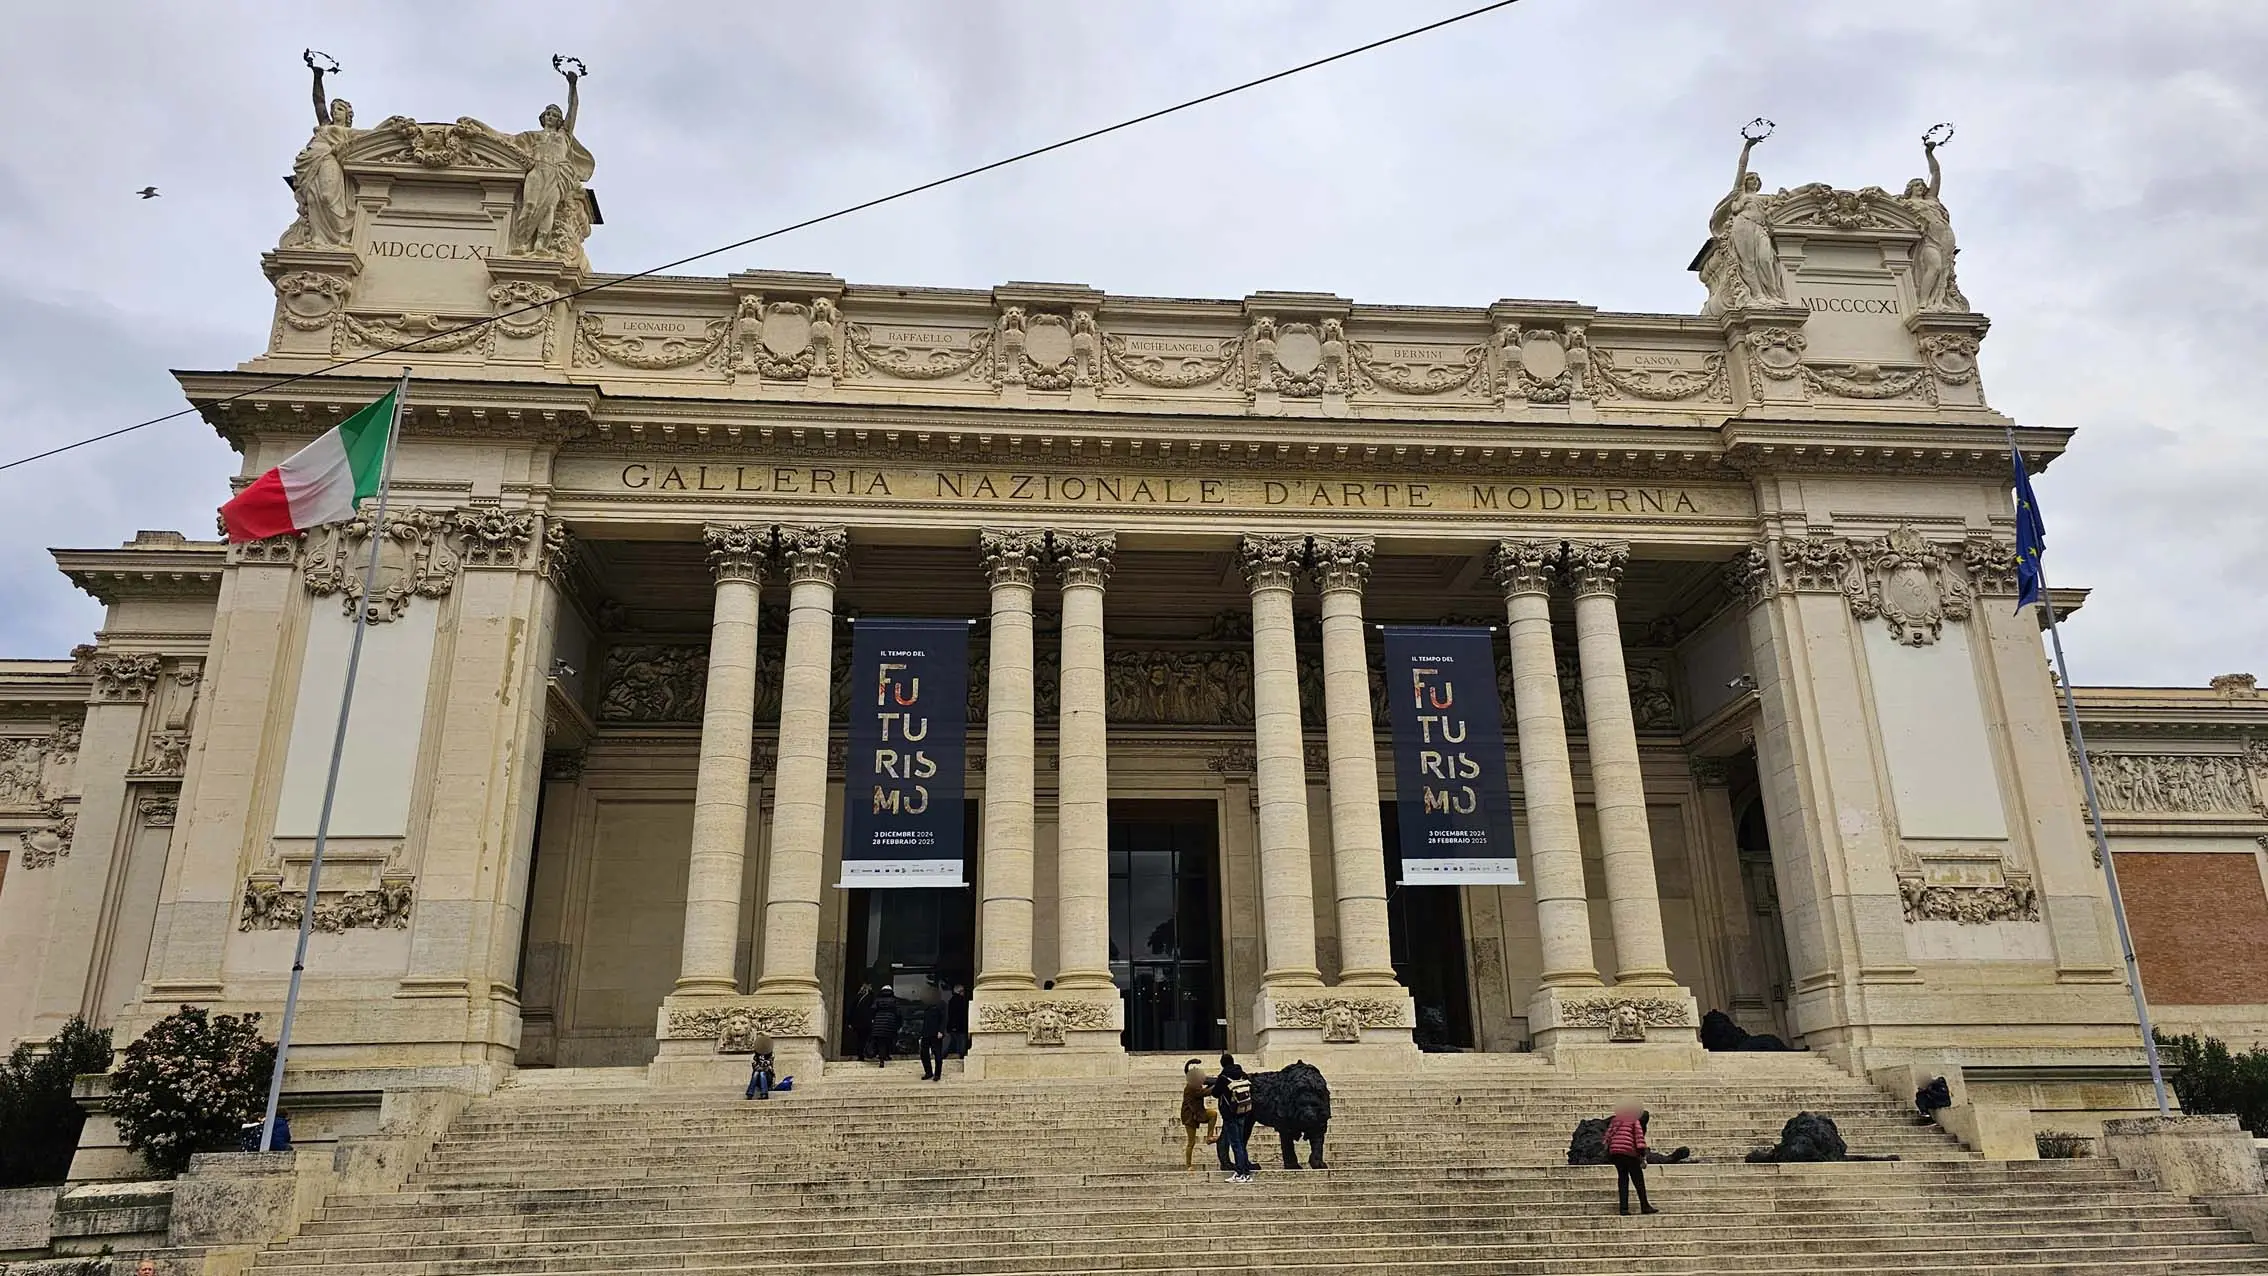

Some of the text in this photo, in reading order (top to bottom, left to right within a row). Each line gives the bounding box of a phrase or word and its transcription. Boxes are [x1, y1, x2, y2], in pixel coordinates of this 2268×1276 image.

[368, 240, 493, 260] MDCCCLXI
[1800, 297, 1899, 314] MDCCCCXI
[623, 322, 686, 332] LEONARDO
[888, 332, 952, 343] RAFFAELLO
[1130, 340, 1214, 352] MICHELANGELO
[1393, 349, 1442, 359] BERNINI
[1635, 356, 1681, 366] CANOVA
[621, 463, 1699, 513] GALLERIA NAZIONALE D'ARTE MODERNA
[877, 713, 927, 742] TU
[1417, 715, 1466, 743] TU
[875, 749, 937, 779] RIS
[1420, 751, 1481, 779] RIS
